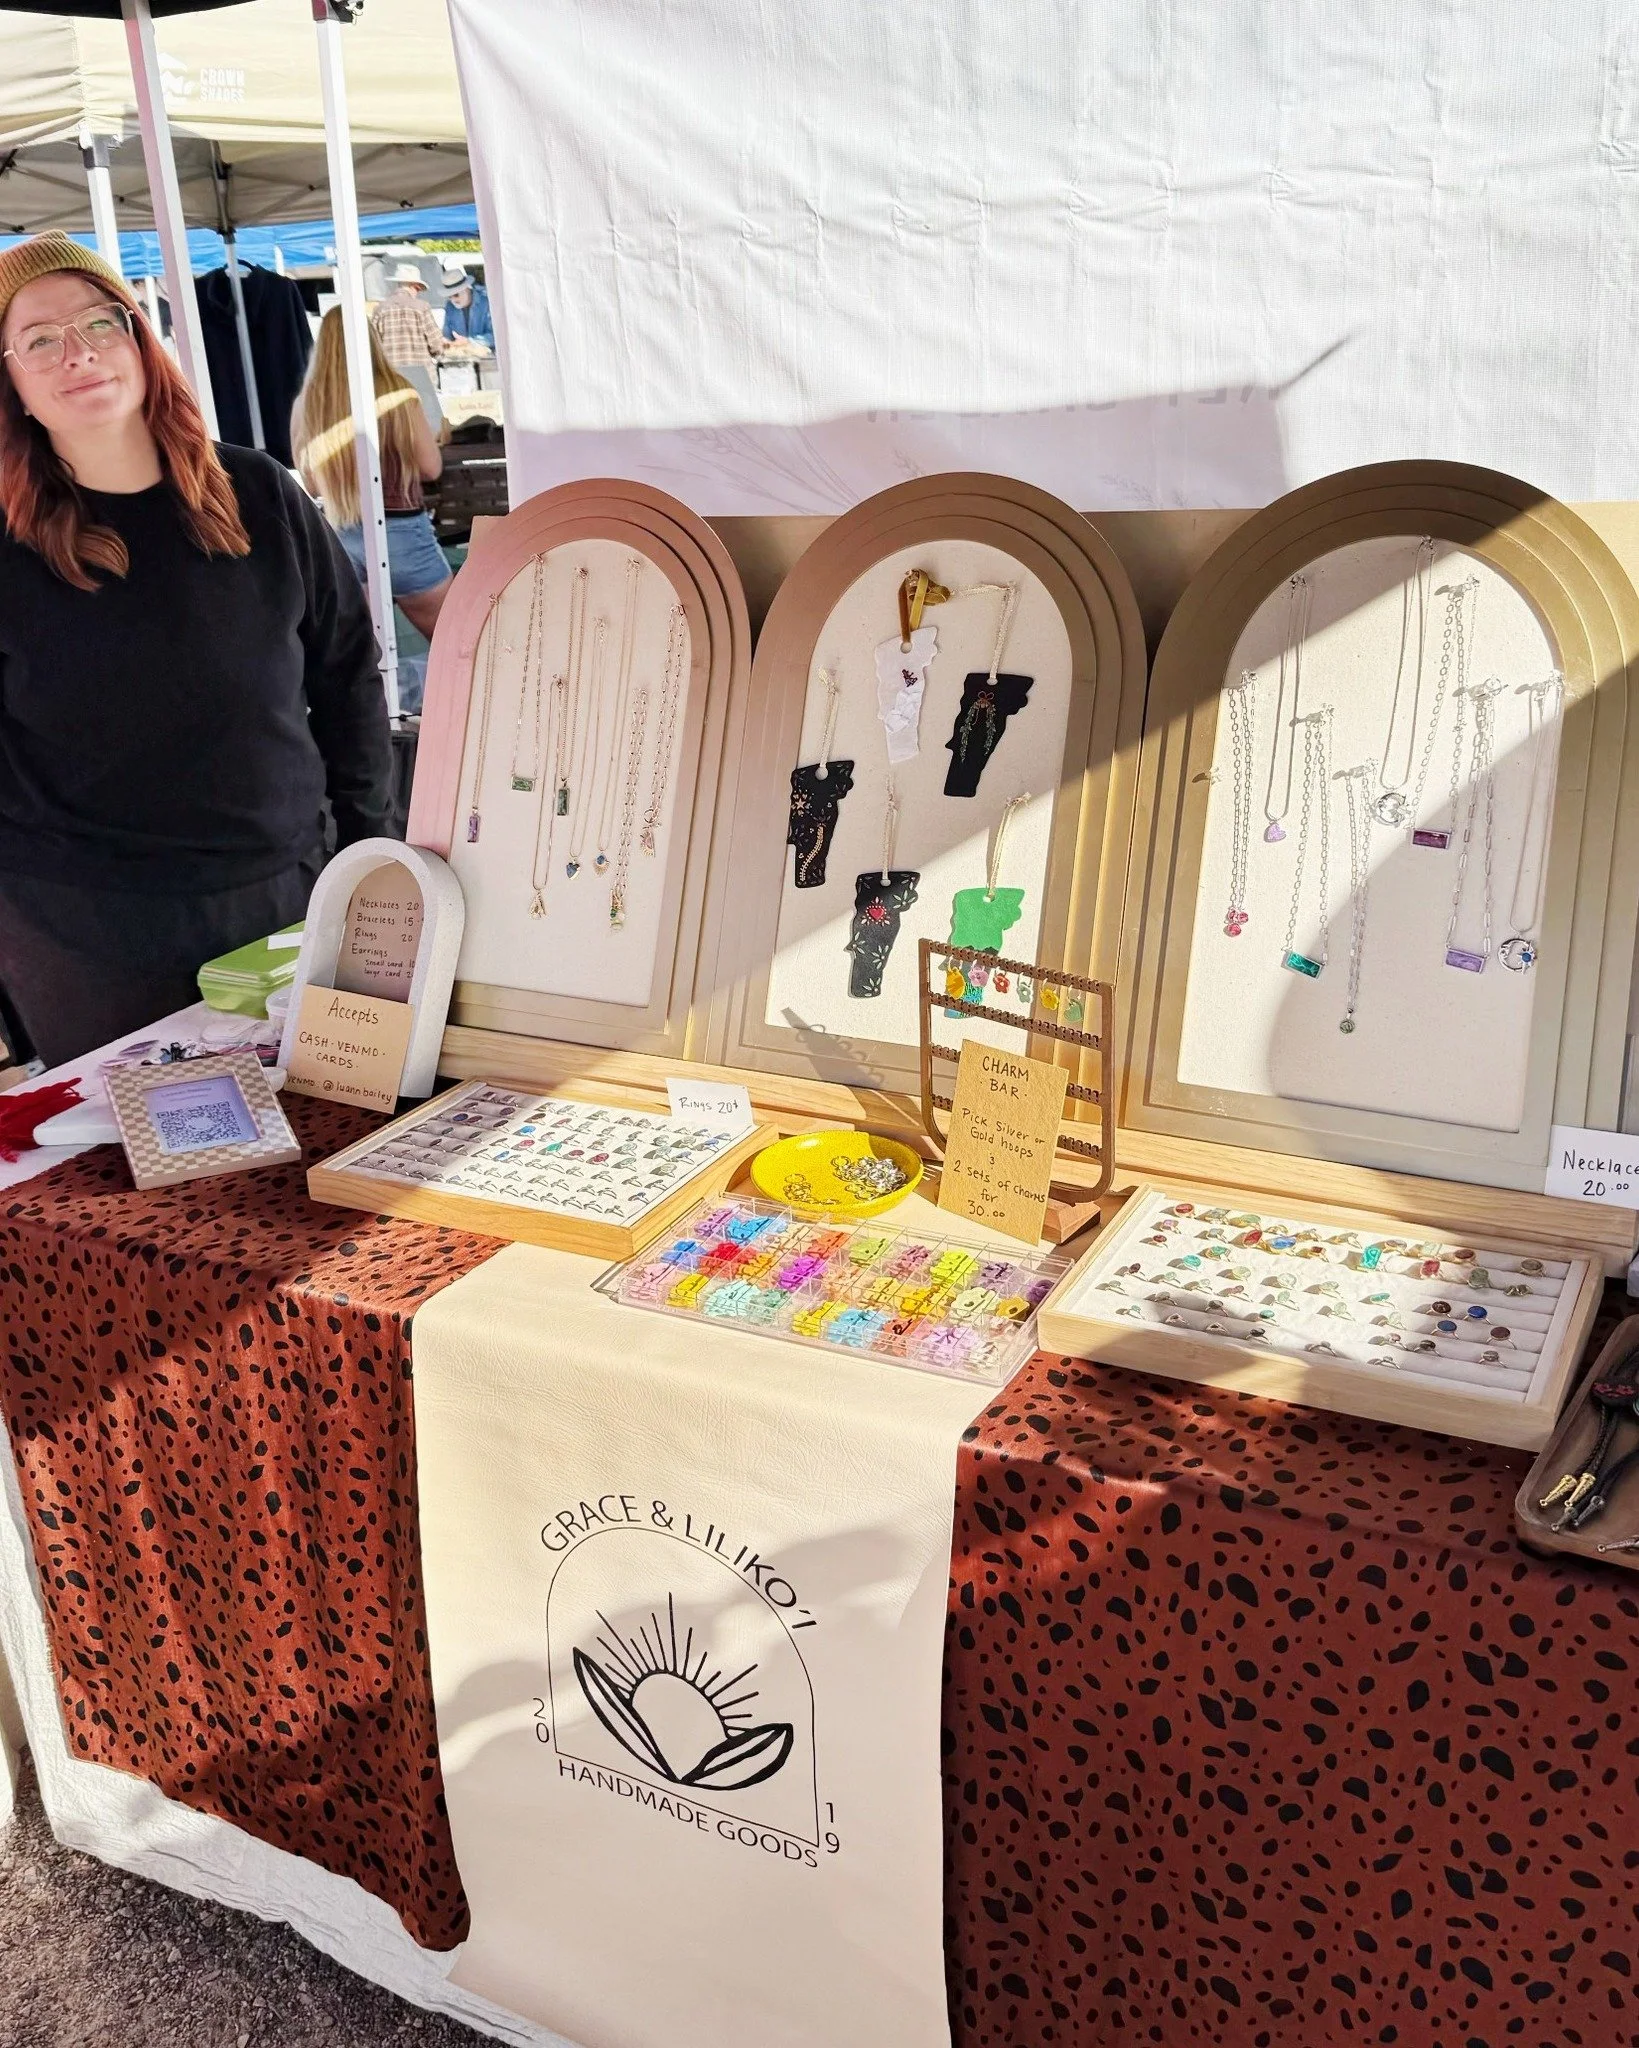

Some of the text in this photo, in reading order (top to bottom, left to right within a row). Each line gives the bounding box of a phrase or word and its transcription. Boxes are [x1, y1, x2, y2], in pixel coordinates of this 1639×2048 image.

[356, 912, 395, 925] Bracelets
[354, 927, 413, 942] Rings 20
[351, 943, 388, 958] Earrings
[327, 996, 379, 1027] Accepts
[299, 1031, 379, 1057] CASH VENMO
[316, 1052, 354, 1069] CARDS
[982, 1055, 1029, 1082] CHARM
[678, 1096, 712, 1112] Rings
[970, 1126, 1034, 1159] Gold hoops
[1034, 1137, 1046, 1145] or
[953, 1159, 962, 1173] 2
[997, 1180, 1011, 1192] of
[980, 1188, 999, 1203] for
[541, 1495, 642, 1552] GRACE
[651, 1500, 674, 1528] &
[558, 1759, 819, 1868] HANDMADE GOODS
